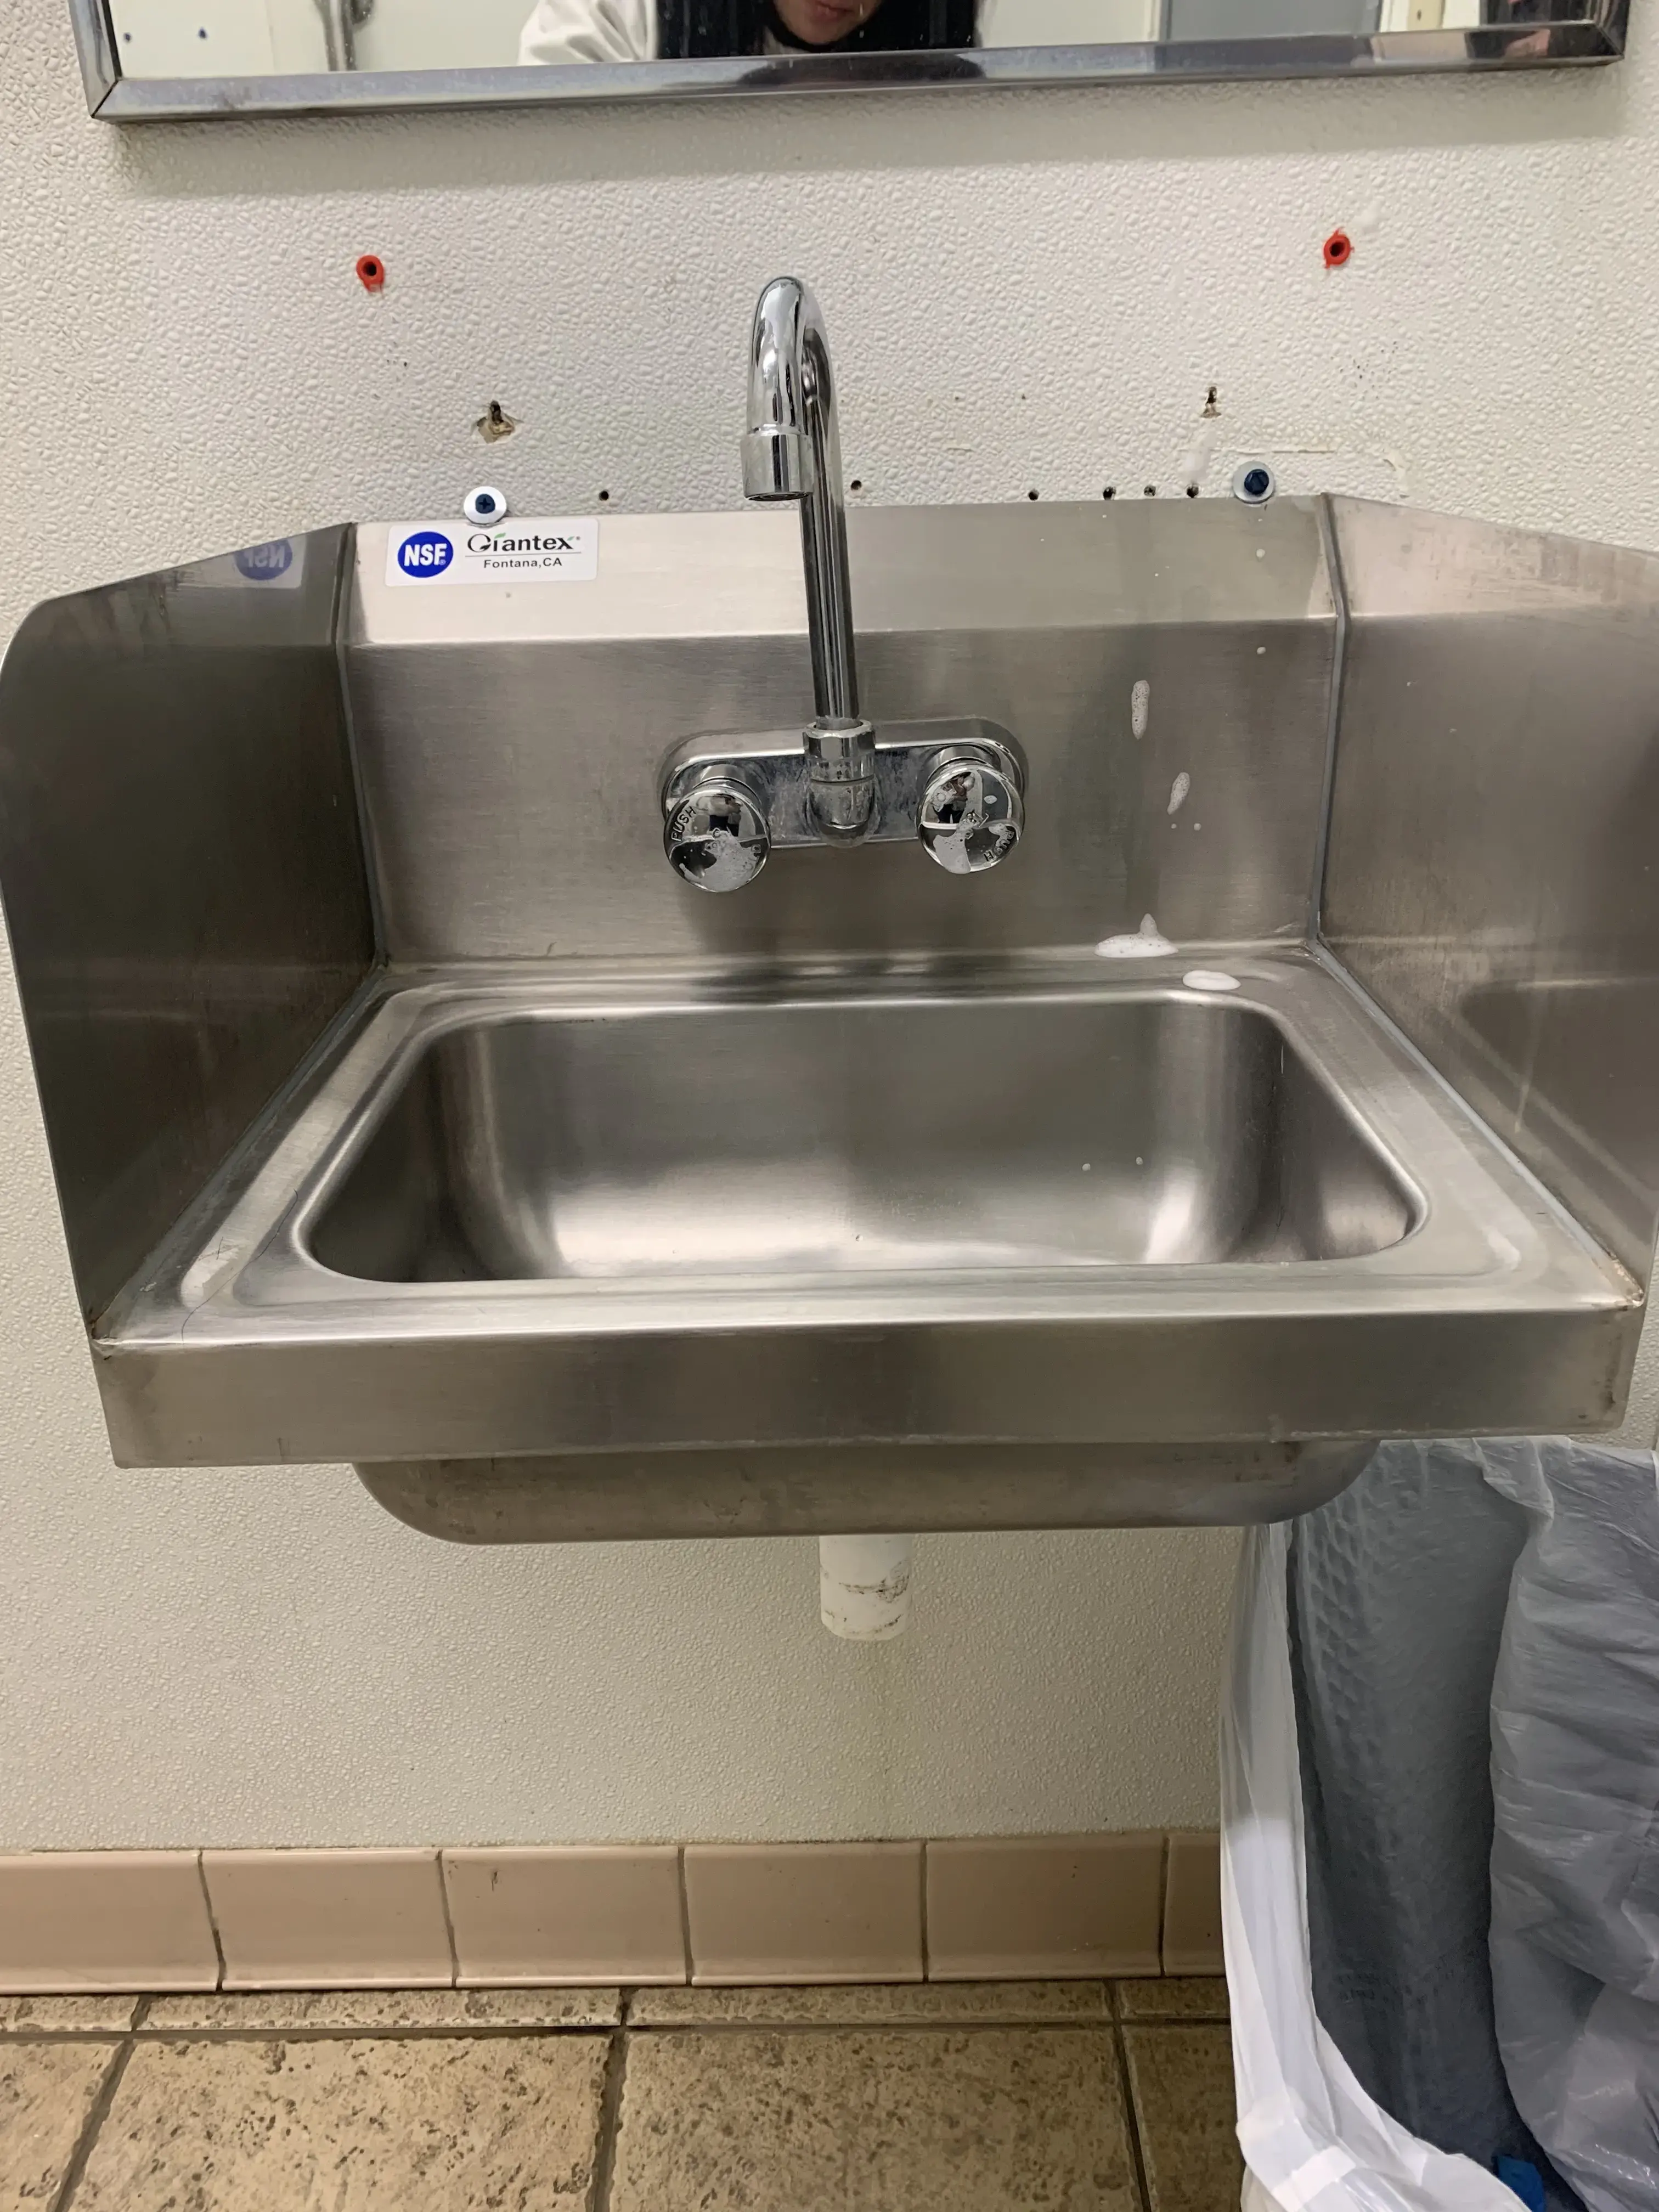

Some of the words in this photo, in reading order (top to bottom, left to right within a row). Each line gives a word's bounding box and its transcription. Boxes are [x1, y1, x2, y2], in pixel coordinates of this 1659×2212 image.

[404, 543, 447, 567] NSF
[467, 533, 574, 553] Giantex
[671, 806, 697, 842] PUSH
